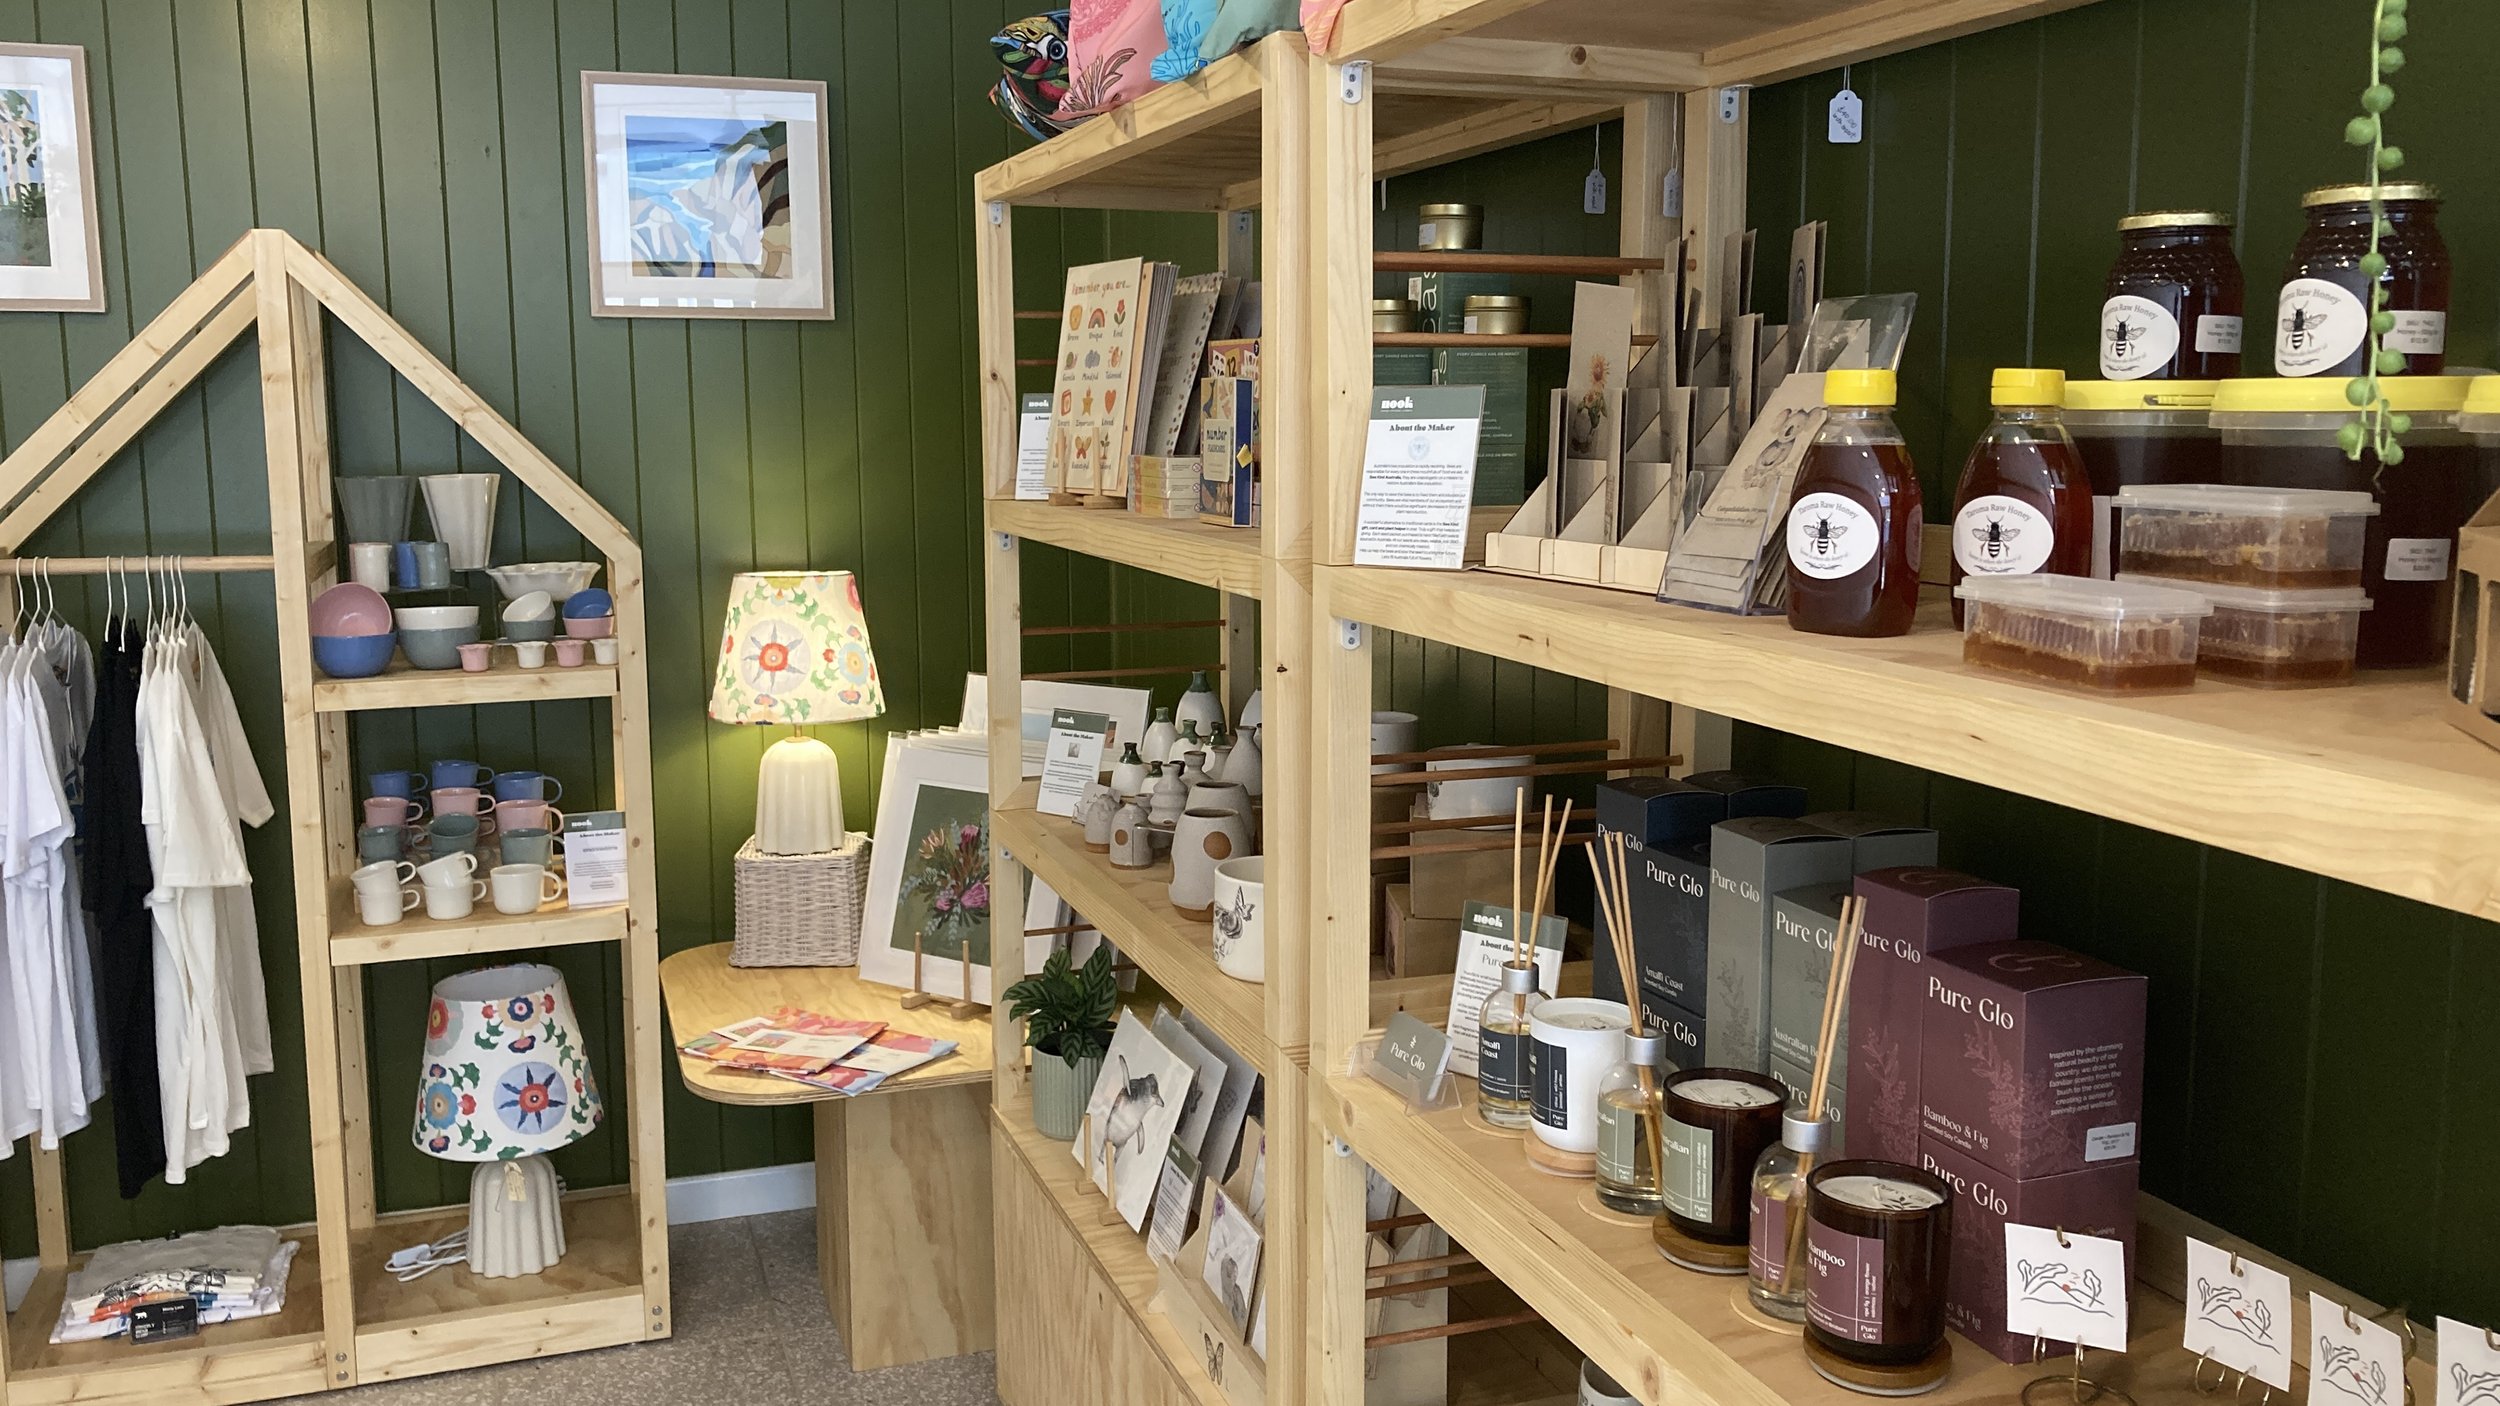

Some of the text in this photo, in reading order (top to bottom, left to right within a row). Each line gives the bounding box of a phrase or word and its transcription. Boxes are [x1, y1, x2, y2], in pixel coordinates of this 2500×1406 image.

[1072, 282, 1100, 295] Remember
[1102, 282, 1114, 298] you
[2296, 288, 2341, 305] Raw Honey
[2120, 304, 2158, 320] Raw Honey
[1113, 329, 1123, 338] Kind
[1227, 356, 1237, 377] 12
[1381, 396, 1413, 409] nook
[1207, 427, 1228, 440] number
[1820, 501, 1835, 509] Raw
[1836, 503, 1859, 520] Honey
[1990, 504, 2006, 512] Raw
[2007, 506, 2031, 522] Honey
[1057, 716, 1074, 724] nook
[1625, 833, 1643, 853] Glo
[1646, 860, 1704, 898] Pure Glo
[1711, 868, 1760, 903] Pure Glo
[1473, 913, 1503, 928] nook
[1776, 910, 1811, 943] Pure
[1480, 940, 1514, 953] About the
[1895, 939, 1921, 963] Glo
[1645, 965, 1684, 992] Amalfi Coast
[1929, 976, 2014, 1030] Pure Glo
[1642, 1003, 1697, 1047] Pure Glo
[1774, 1027, 1809, 1053] Australian
[1390, 1042, 1426, 1071] Pure Glo
[1481, 1046, 1498, 1059] Coast
[2049, 1049, 2076, 1060] Inspired
[2085, 1046, 2096, 1054] the
[2096, 1043, 2123, 1052] stunning
[2054, 1059, 2077, 1068] natural
[2077, 1055, 2100, 1065] beauty
[2100, 1053, 2107, 1061] of
[2074, 1075, 2094, 1084] scents
[2056, 1087, 2073, 1096] bush
[2088, 1092, 2107, 1101] sense
[2107, 1089, 2114, 1097] of
[2077, 1104, 2090, 1112] and
[1552, 1113, 1565, 1121] Pure
[1923, 1120, 1972, 1150] Scented Soy Candle
[1924, 1105, 1989, 1150] Bamboo & Fig
[1972, 1182, 2008, 1216] Glo
[1694, 1204, 1708, 1213] Pure
[1807, 1237, 1846, 1268] Bamboo
[1767, 1267, 1781, 1275] Pure
[1813, 1256, 1828, 1277] Fig
[1768, 1273, 1779, 1281] Glo
[1860, 1324, 1878, 1333] Pure
[1862, 1331, 1876, 1340] Glo
